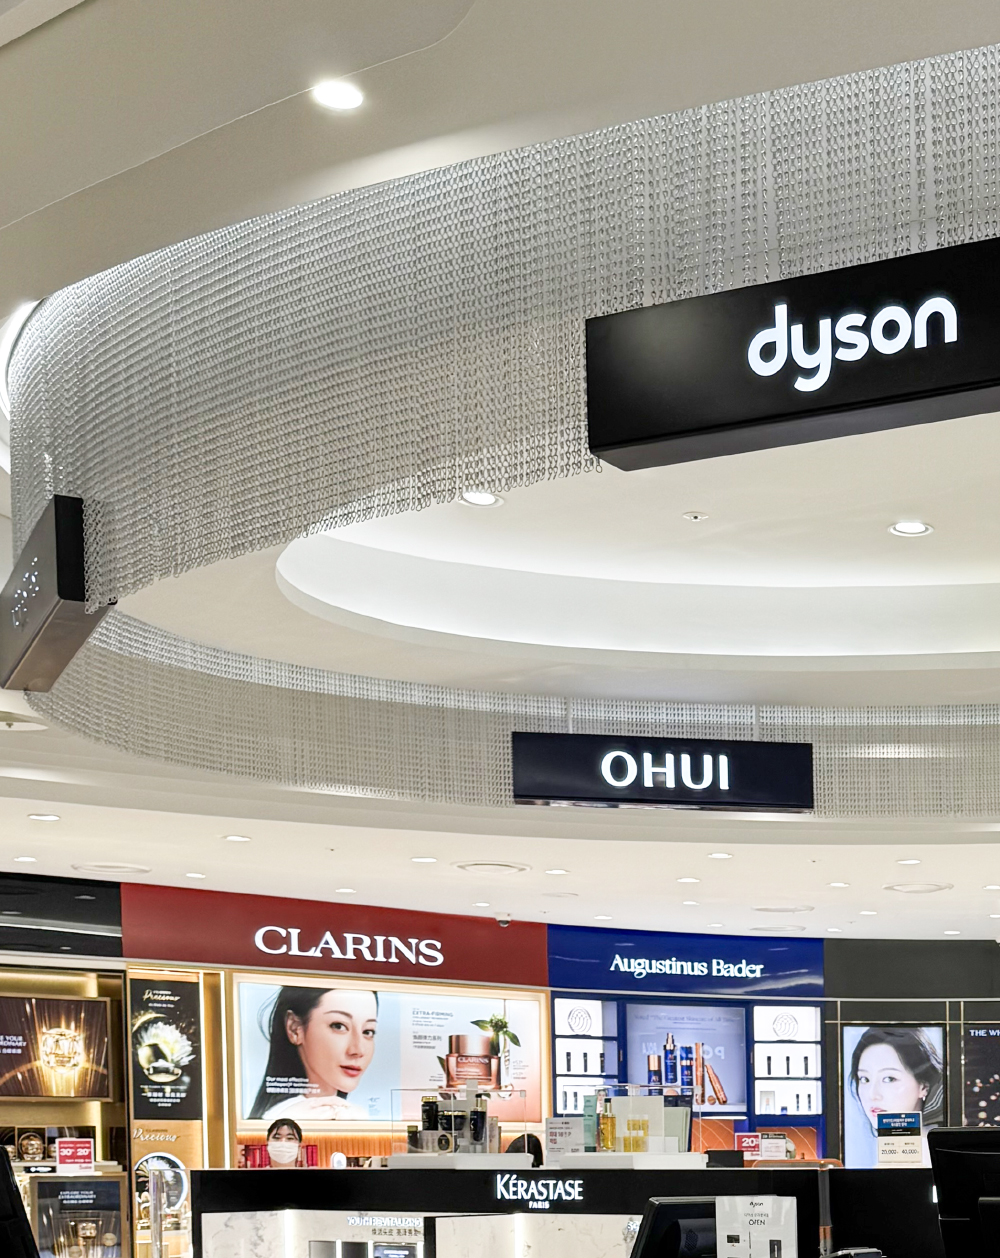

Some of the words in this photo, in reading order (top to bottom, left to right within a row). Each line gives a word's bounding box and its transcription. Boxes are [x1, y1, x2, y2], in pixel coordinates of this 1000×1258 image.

[747, 296, 958, 392] dyson
[601, 750, 730, 790] OHUI
[254, 925, 445, 967] CLARINS
[609, 954, 709, 979] Augustinus
[711, 958, 765, 978] Bader
[969, 1029, 987, 1037] THE
[496, 1173, 584, 1200] KÉRASTASE
[528, 1201, 550, 1209] PARIS
